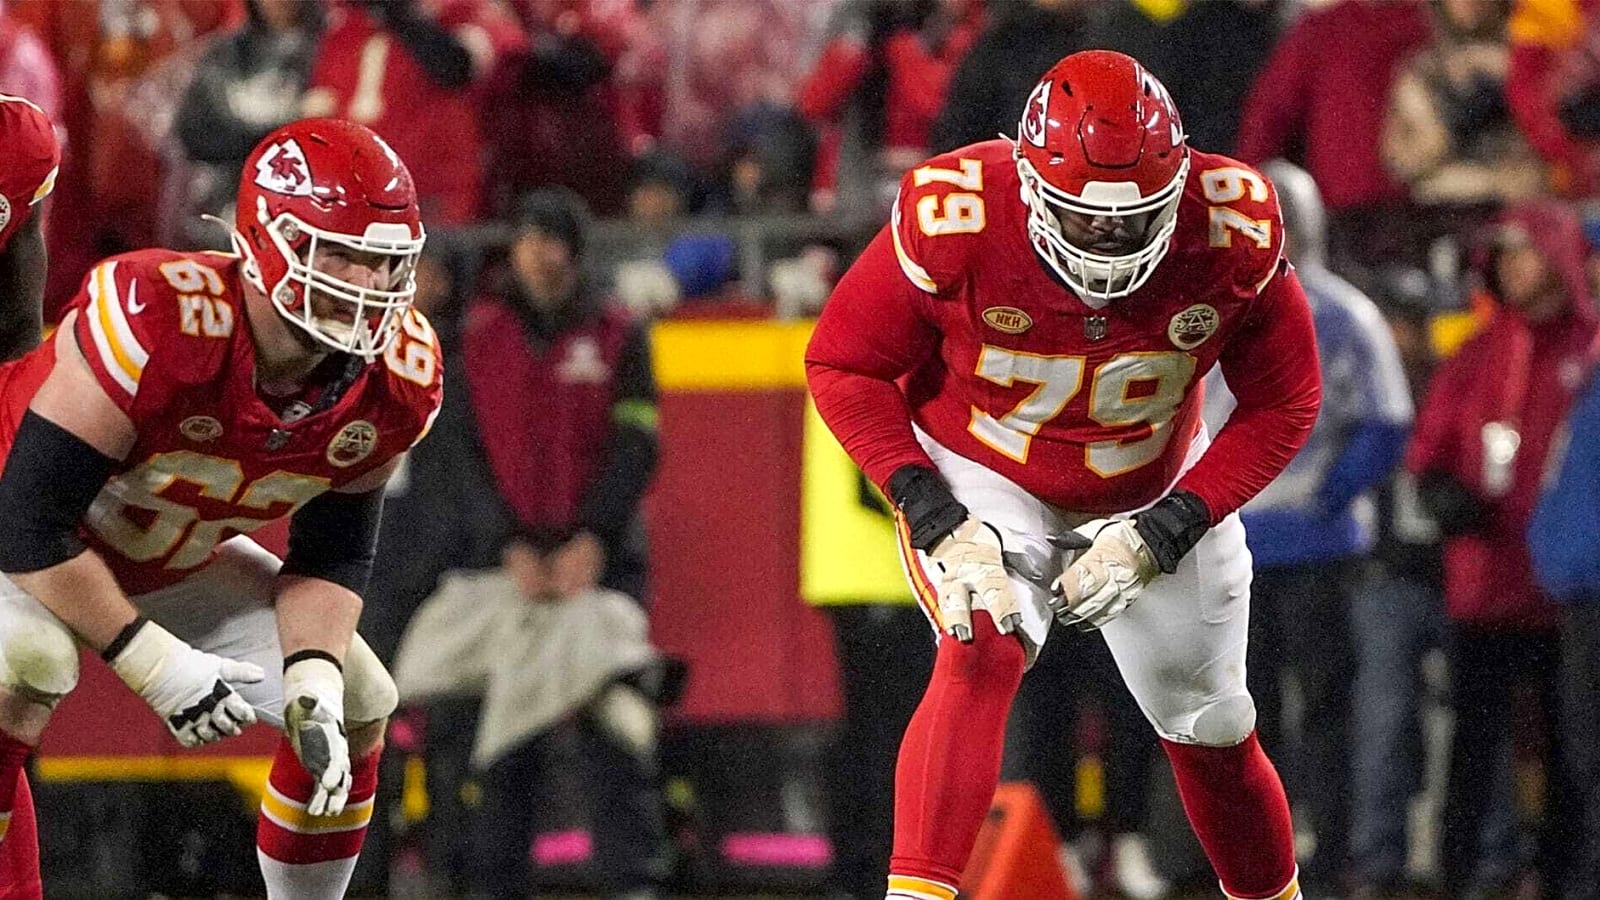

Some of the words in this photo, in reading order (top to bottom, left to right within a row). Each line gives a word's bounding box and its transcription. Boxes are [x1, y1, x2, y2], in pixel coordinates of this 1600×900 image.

[913, 158, 986, 237] 79
[1200, 166, 1272, 249] 79
[158, 259, 233, 337] 62
[995, 313, 1021, 328] NKH
[967, 344, 1198, 479] 79
[87, 450, 331, 570] 62
